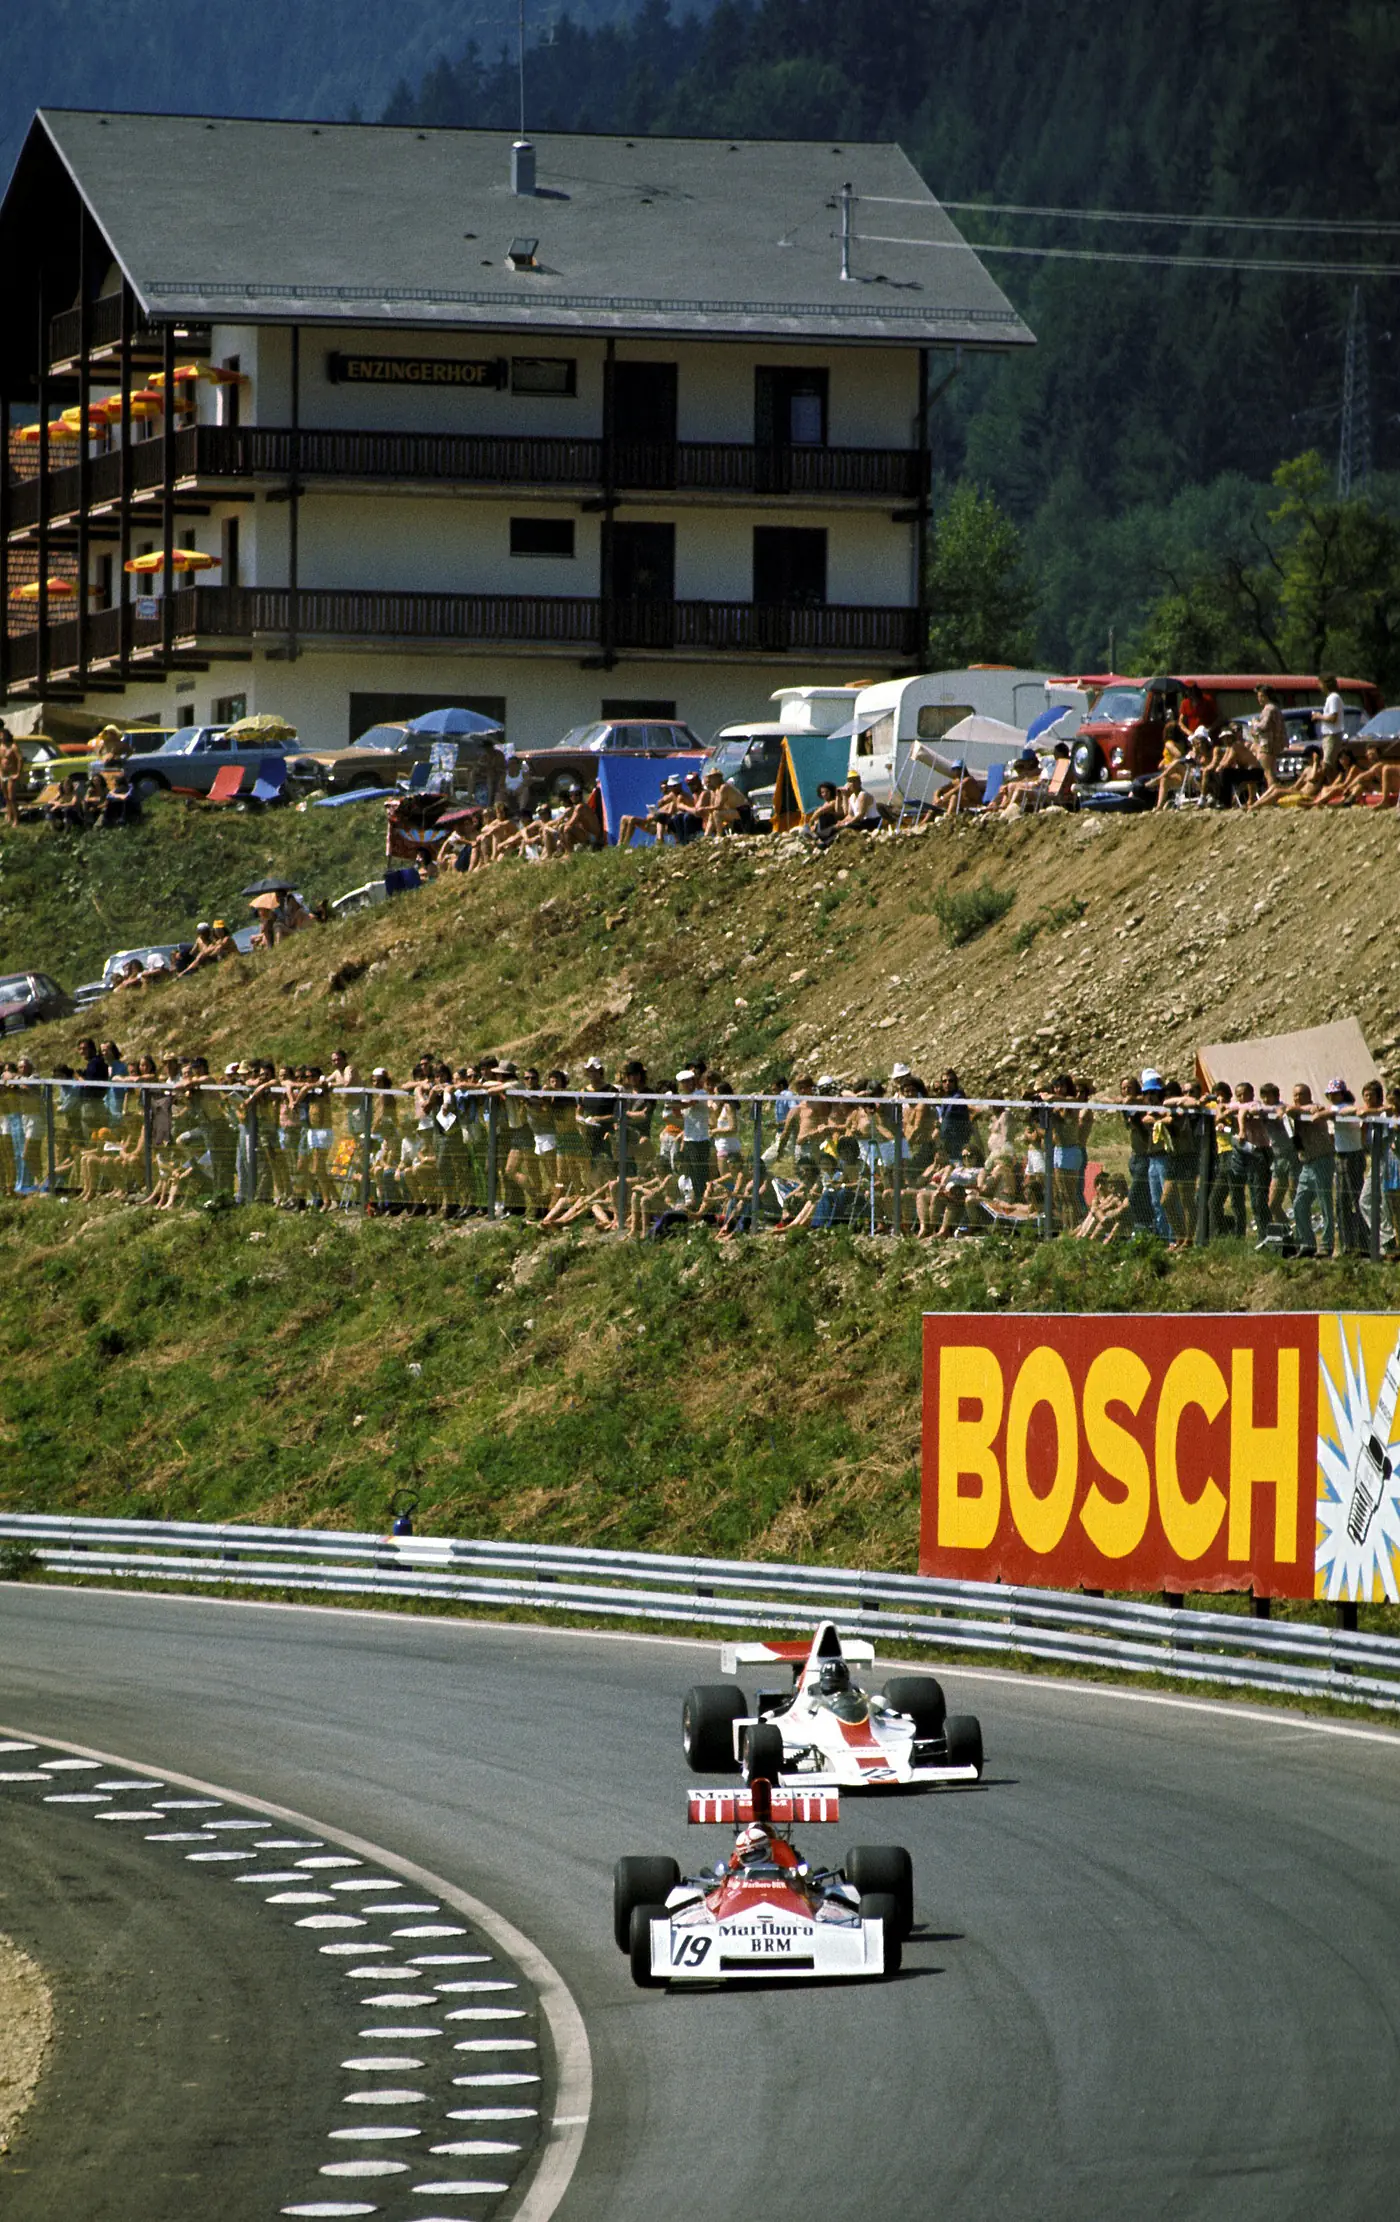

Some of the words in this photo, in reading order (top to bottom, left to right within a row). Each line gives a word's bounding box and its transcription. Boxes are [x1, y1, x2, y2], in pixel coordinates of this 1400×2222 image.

[347, 360, 487, 382] ENZINGERHOF
[938, 1346, 1300, 1563] BOSCH
[861, 1767, 897, 1780] 12
[695, 1791, 825, 1799] Maroro
[718, 1923, 814, 1937] Marlboro
[672, 1934, 713, 1967] 19
[751, 1938, 792, 1953] BRM
